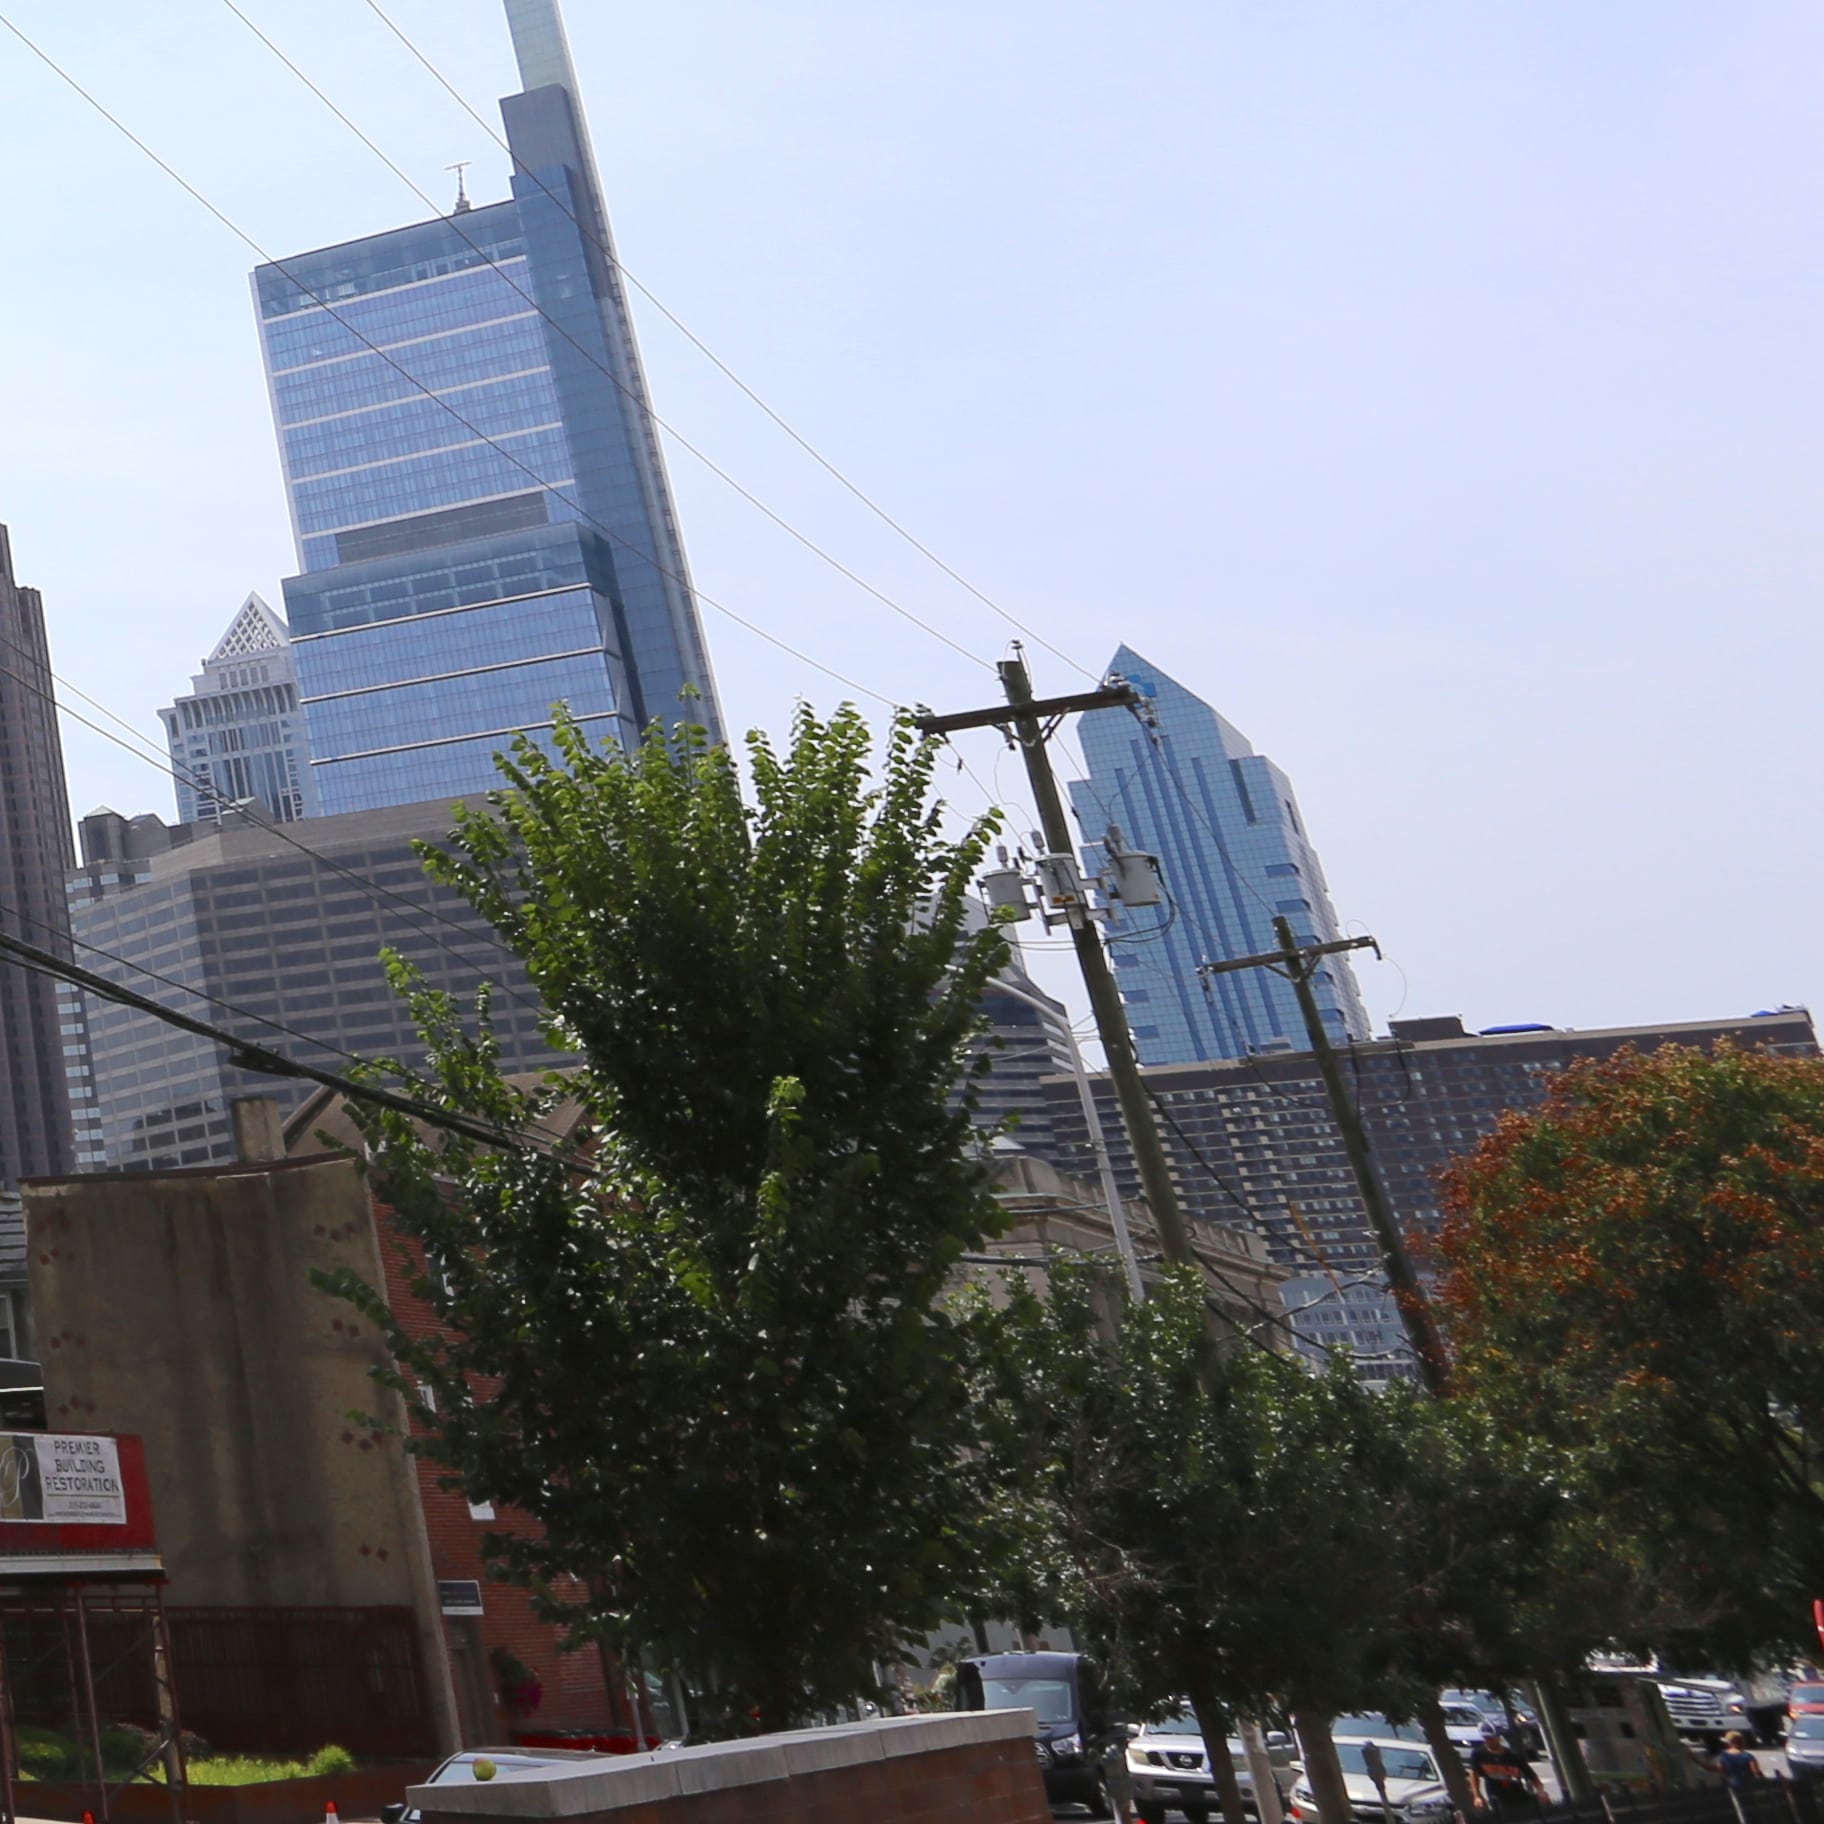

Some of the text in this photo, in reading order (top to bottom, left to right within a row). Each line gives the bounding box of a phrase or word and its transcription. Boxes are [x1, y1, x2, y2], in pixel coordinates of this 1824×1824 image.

[54, 1440, 101, 1455] PREMIER
[55, 1458, 105, 1474] BUILDING
[45, 1476, 120, 1493] RESTORATION
